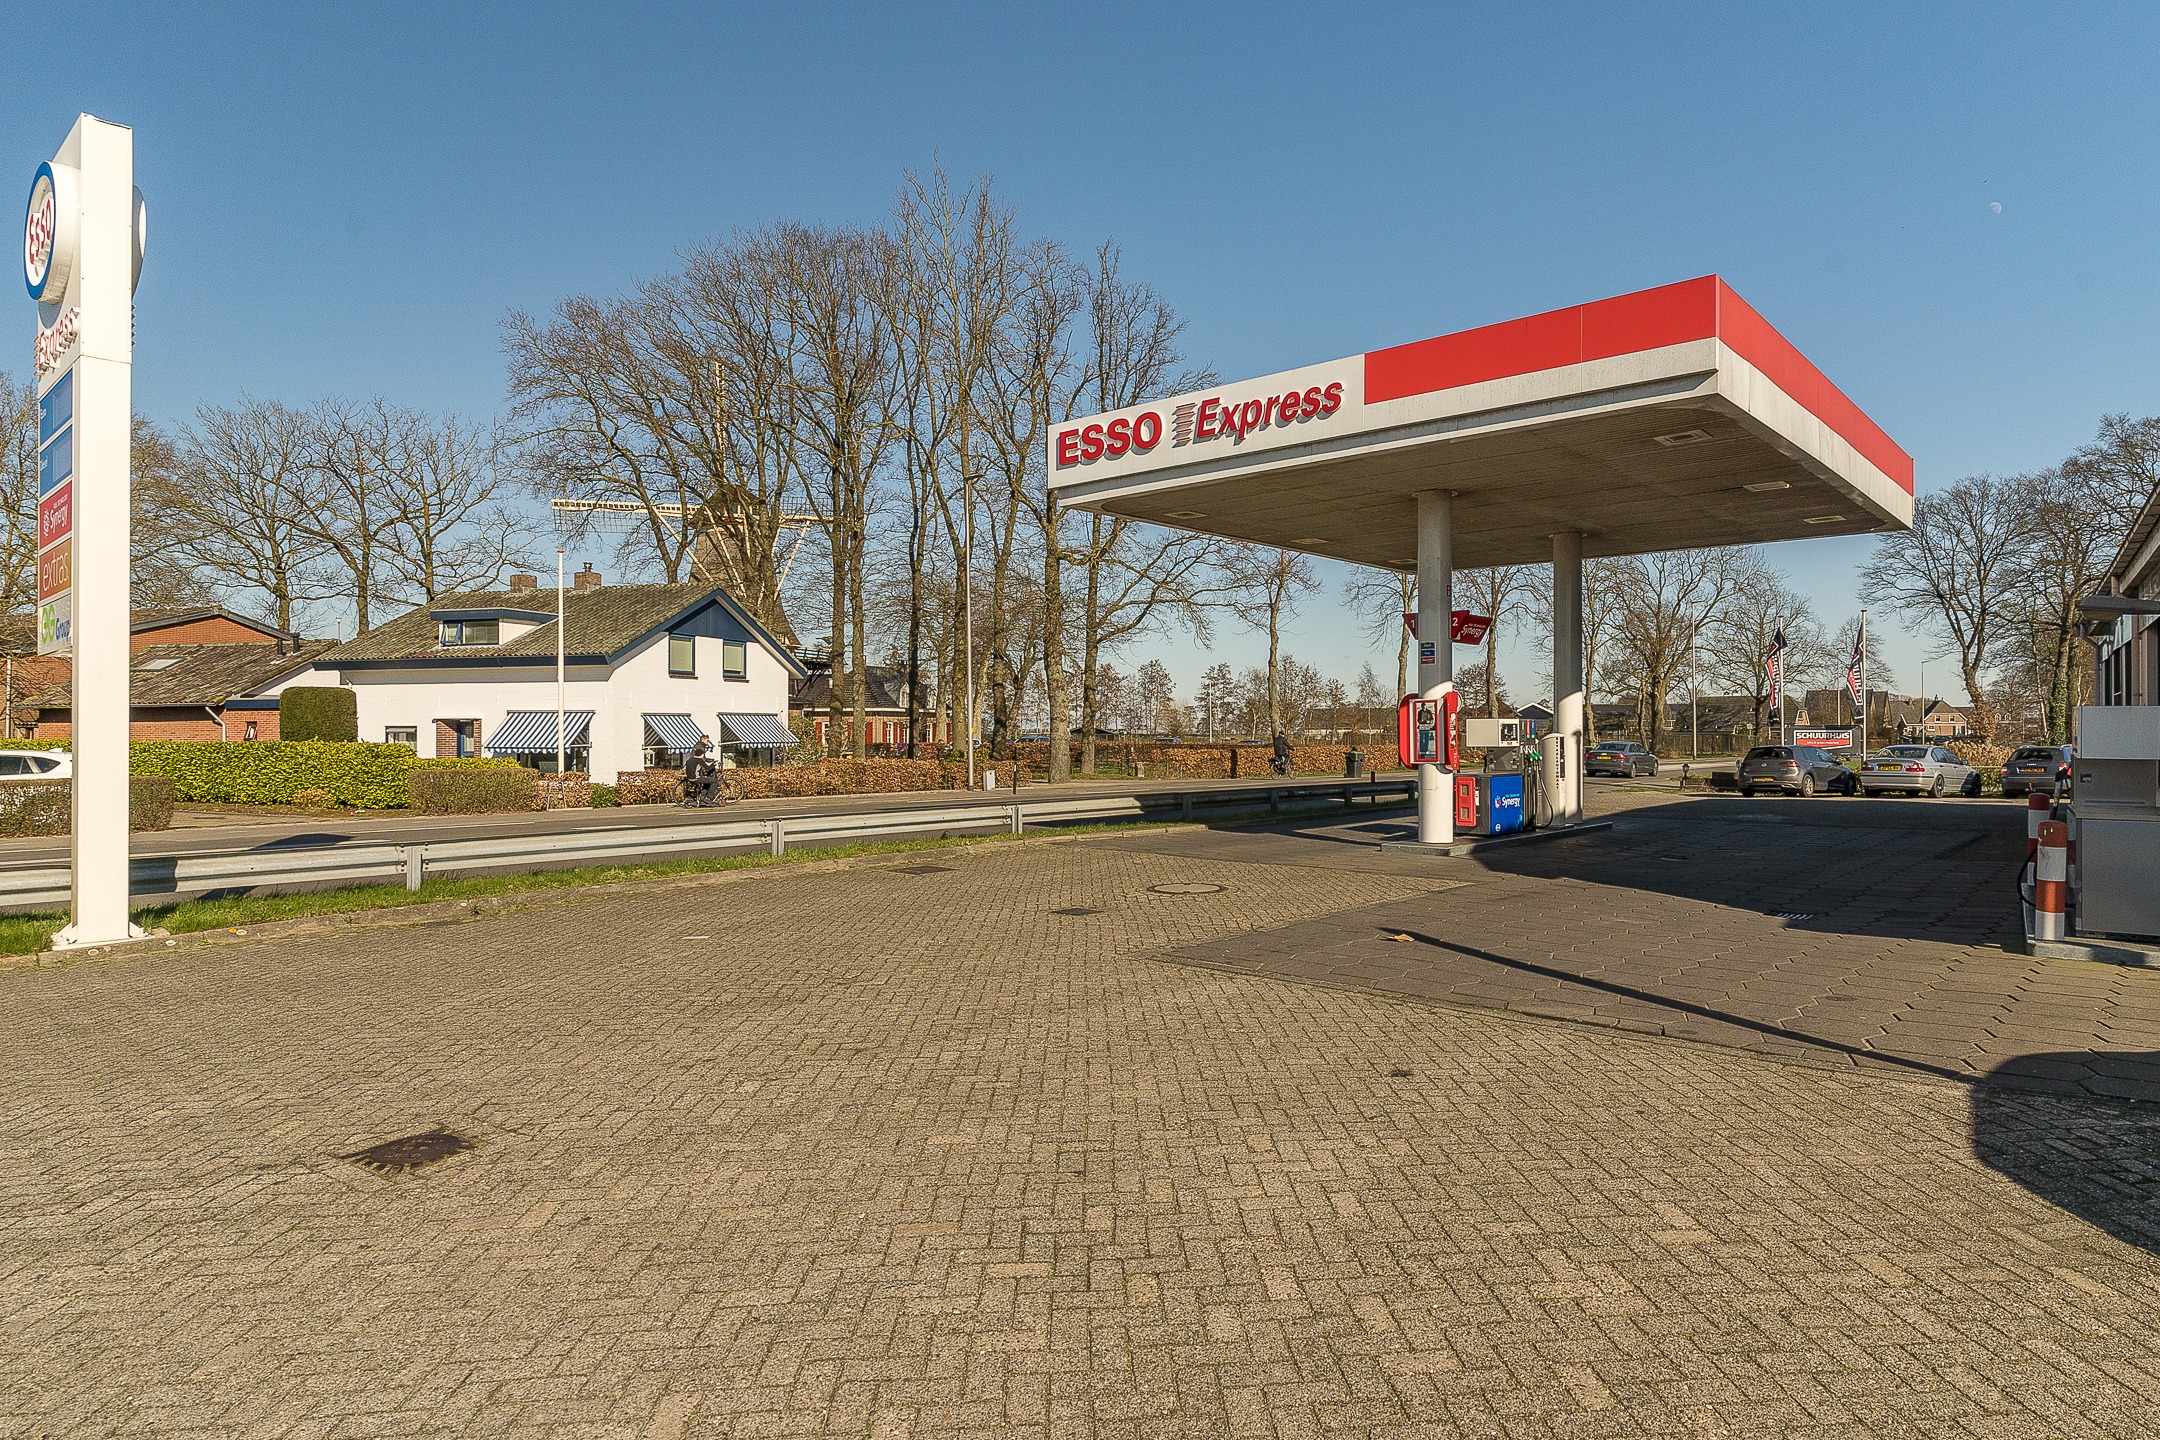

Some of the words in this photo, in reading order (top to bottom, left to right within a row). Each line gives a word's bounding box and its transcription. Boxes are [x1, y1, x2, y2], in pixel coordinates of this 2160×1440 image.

[1059, 411, 1163, 465] ESSO
[1196, 381, 1345, 439] Express
[50, 504, 69, 533] Synergy
[43, 553, 69, 592] extras
[56, 617, 71, 642] Group
[1410, 619, 1415, 628] 1
[1452, 617, 1459, 627] 2
[1461, 624, 1485, 638] Synergy
[1502, 797, 1520, 808] Synergy
